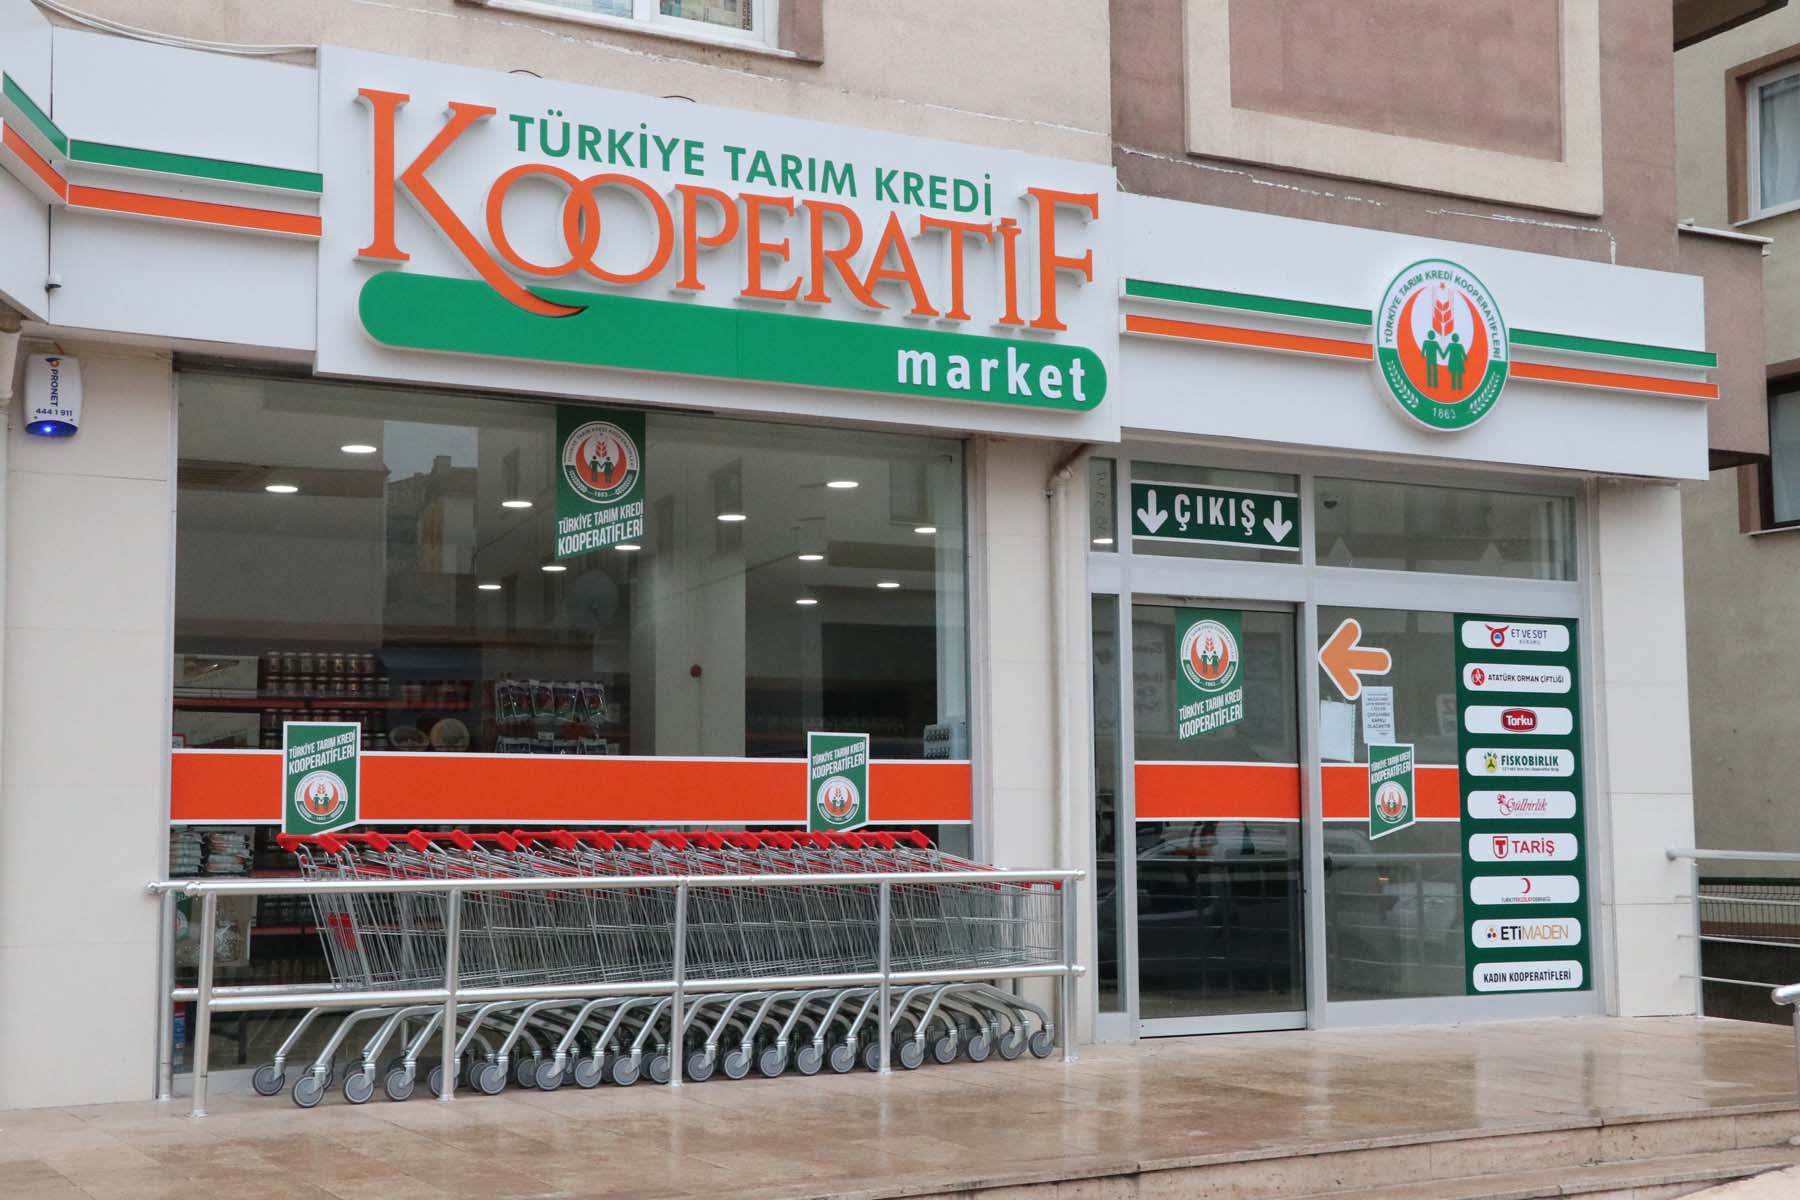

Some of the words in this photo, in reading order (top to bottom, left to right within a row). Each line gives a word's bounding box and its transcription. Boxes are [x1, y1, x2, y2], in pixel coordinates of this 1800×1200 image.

[509, 109, 704, 176] TÜRKİYE
[723, 145, 857, 198] TARIM
[875, 167, 992, 216] KREDİ
[357, 87, 1099, 331] KOOPERATİF
[1385, 295, 1401, 343] TÜRKİYE
[1399, 273, 1424, 296] TARIM
[1425, 270, 1453, 280] KREDİ
[1454, 275, 1502, 359] KOOPERATİFLERİ
[50, 369, 59, 407] PRONET
[897, 347, 1085, 401] market
[558, 513, 592, 534] TÜRKİYE
[594, 507, 619, 526] TARIM
[620, 499, 643, 519] KREDİ
[1174, 494, 1255, 536] ÇIKIŞ
[558, 515, 643, 556] KOOPERATİFLERİ
[1511, 629, 1520, 638] ET
[1521, 629, 1532, 638] VE
[1488, 673, 1515, 681] ATATÜRK
[1179, 701, 1204, 721] TÜRKİYE
[1205, 695, 1225, 711] TARIM
[1225, 686, 1242, 704] KREDİ
[1179, 701, 1242, 740] KOOPERATİFLERİ
[1505, 714, 1533, 726] Torku
[289, 742, 315, 759] TÜRKİYE
[317, 736, 336, 751] TARIM
[337, 728, 355, 745] KREDİ
[289, 741, 355, 775] KOOPERATİFLERİ
[1501, 753, 1559, 766] FİSKOBİRLİK
[812, 751, 865, 780] KOOPERATİFLERİ
[1512, 837, 1555, 856] TARİŞ
[1484, 973, 1507, 983] KADIN
